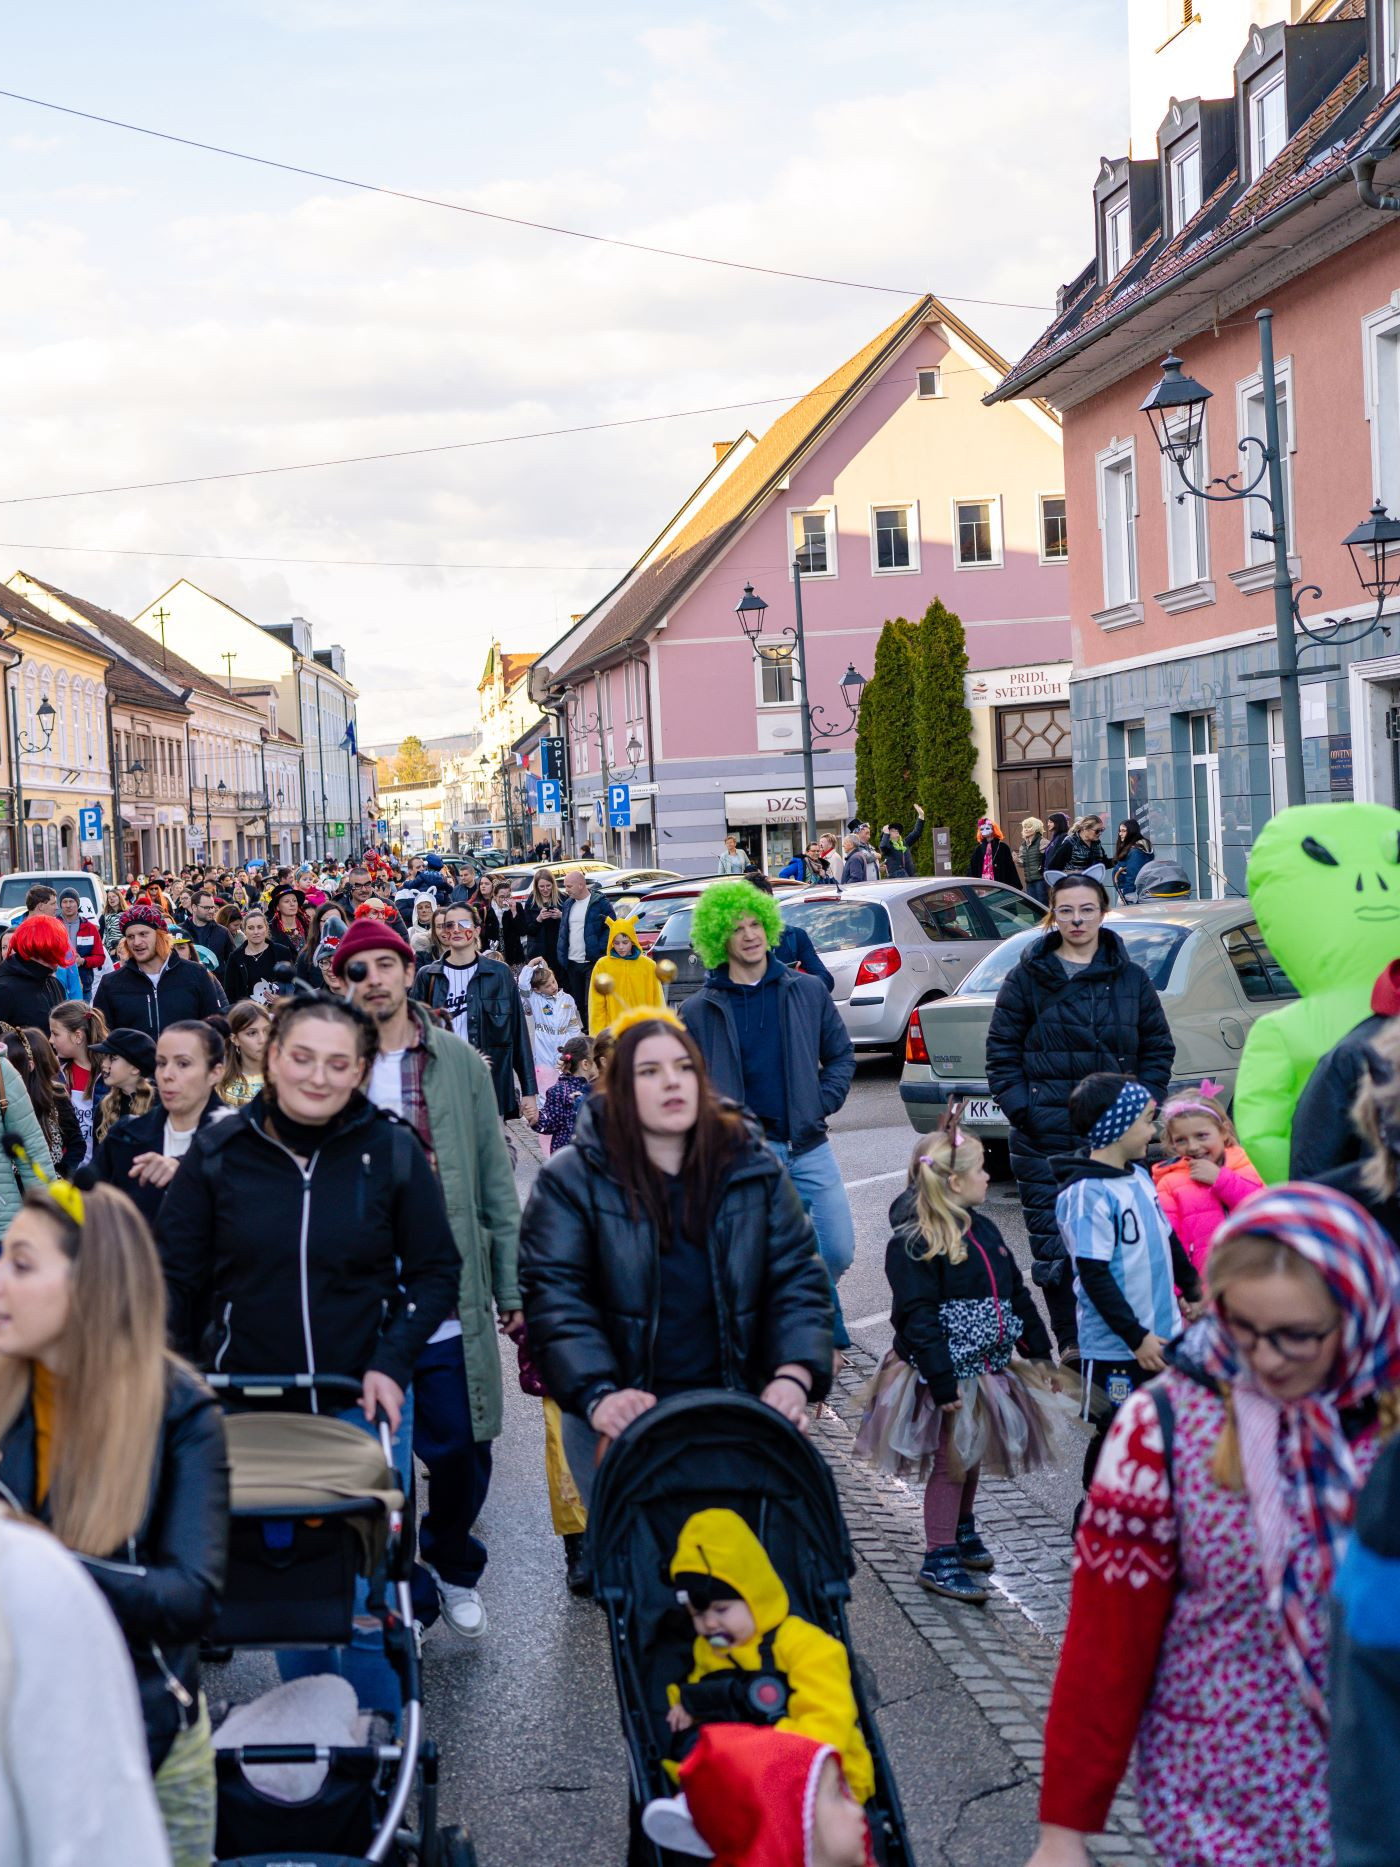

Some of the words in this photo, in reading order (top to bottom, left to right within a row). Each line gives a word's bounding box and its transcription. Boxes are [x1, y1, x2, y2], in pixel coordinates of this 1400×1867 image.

[1010, 671, 1048, 684] PRIDI,
[995, 685, 1032, 699] SVETI
[1034, 683, 1061, 696] DUH
[542, 783, 554, 800] P
[613, 788, 625, 809] P
[766, 796, 807, 813] DZS
[84, 811, 96, 828] P
[765, 815, 806, 824] KNJIGARN
[970, 1101, 989, 1118] KK
[1113, 1207, 1141, 1248] 10
